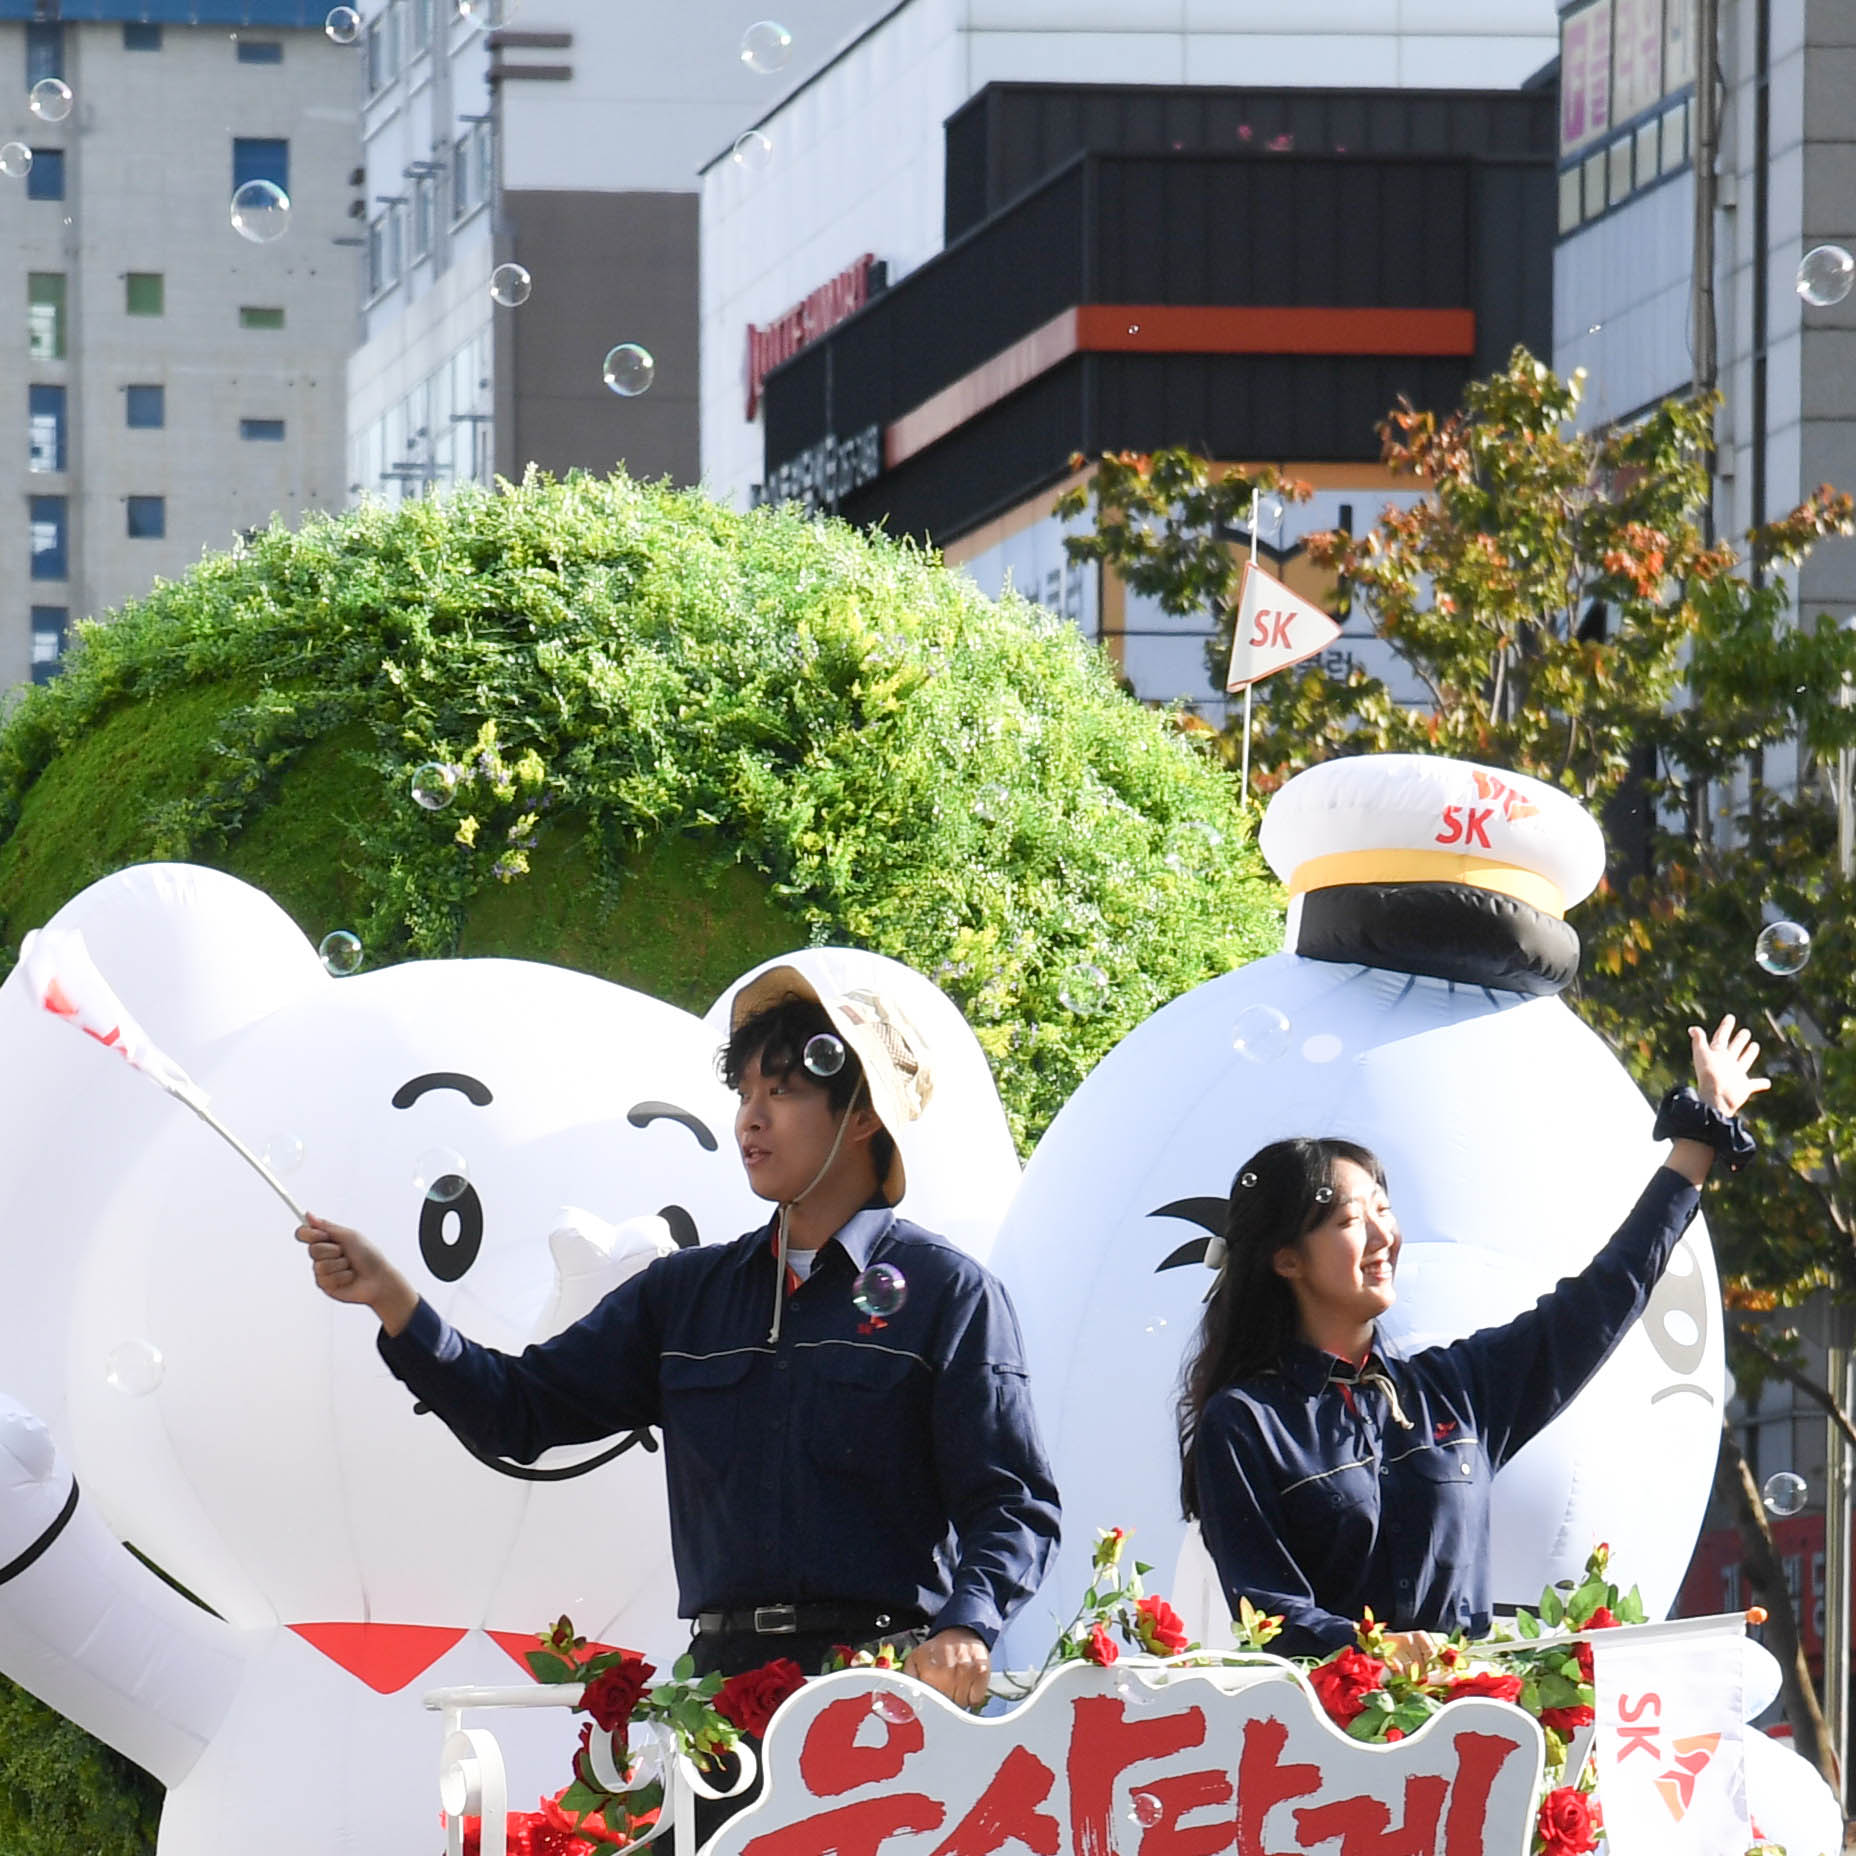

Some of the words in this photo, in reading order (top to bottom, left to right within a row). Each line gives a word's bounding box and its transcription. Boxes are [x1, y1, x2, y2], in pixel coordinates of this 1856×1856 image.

[1249, 609, 1297, 650] SK
[1434, 804, 1494, 850] SK
[1617, 1691, 1662, 1763] SK
